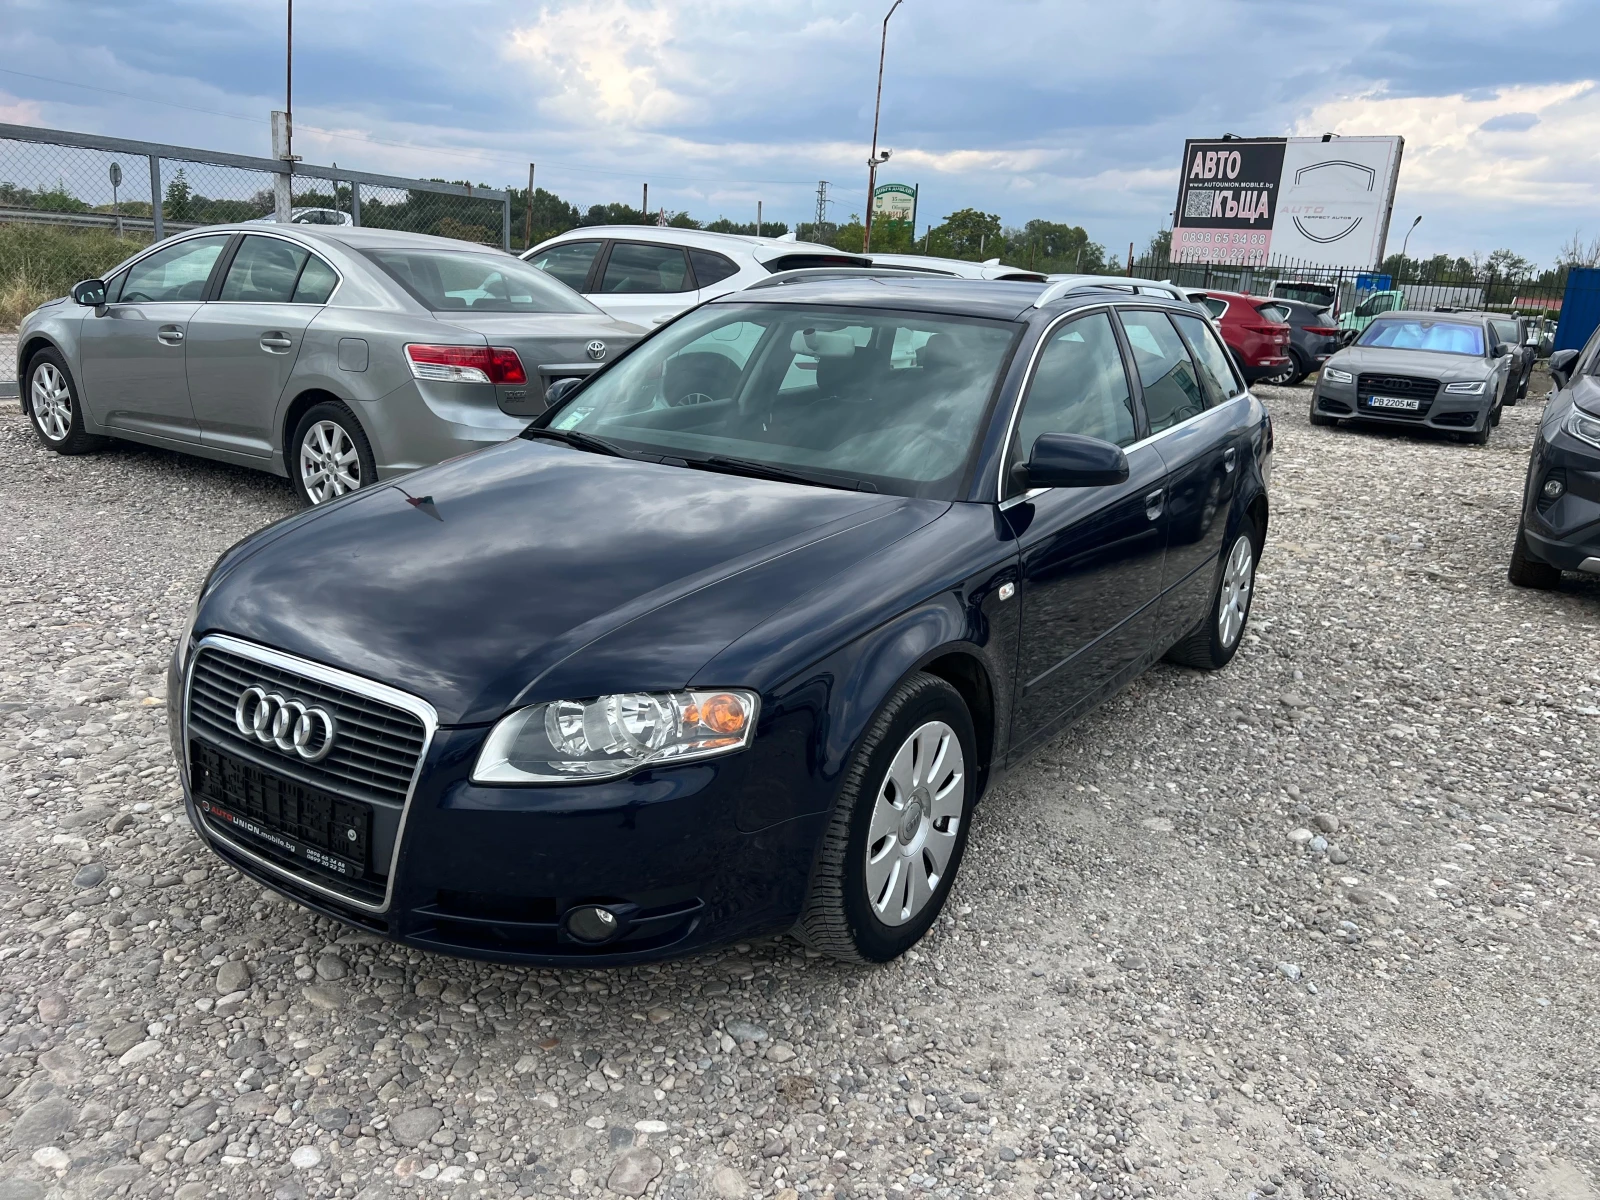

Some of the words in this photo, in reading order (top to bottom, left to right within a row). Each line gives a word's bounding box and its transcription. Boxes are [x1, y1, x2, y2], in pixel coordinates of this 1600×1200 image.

[1190, 151, 1241, 179] АВТО
[1212, 190, 1269, 223] КЪЩА
[1182, 232, 1211, 243] 0898
[1214, 233, 1229, 243] 65
[1232, 233, 1247, 244] 34
[1250, 234, 1266, 245] 88
[1180, 246, 1209, 257] 0899
[1213, 247, 1227, 258] 20
[1230, 248, 1245, 259] 22
[1247, 248, 1264, 259] 20
[1373, 397, 1384, 406] PB
[1385, 398, 1405, 407] 2205
